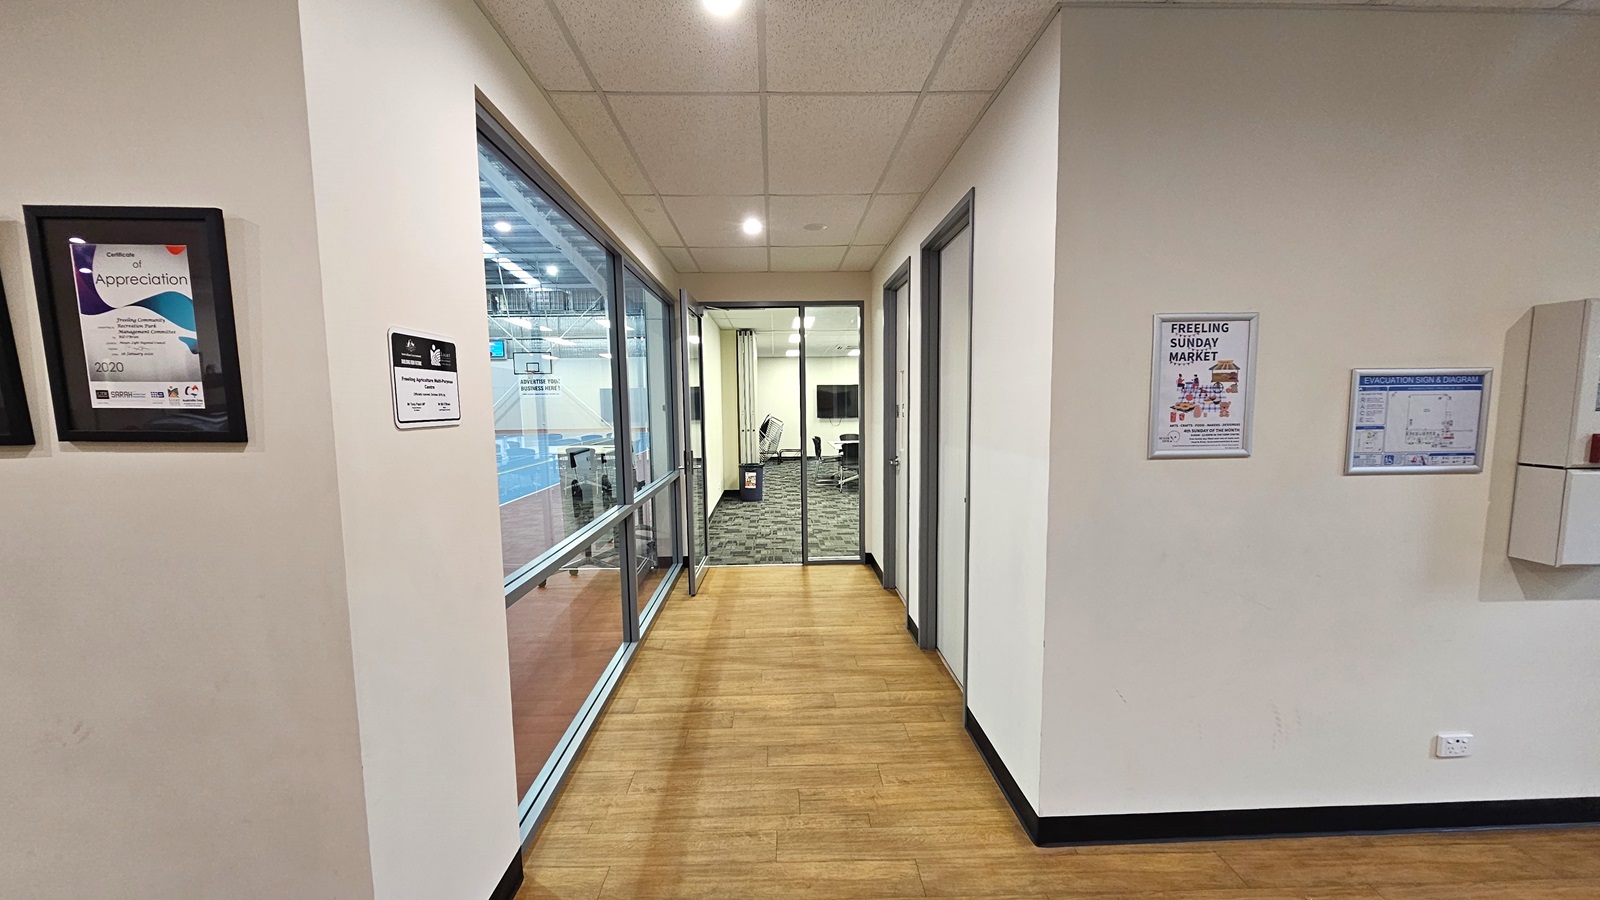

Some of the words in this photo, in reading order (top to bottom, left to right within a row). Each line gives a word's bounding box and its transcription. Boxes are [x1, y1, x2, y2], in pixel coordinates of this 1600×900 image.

[132, 260, 142, 268] of
[96, 273, 188, 287] Appreciation
[1171, 323, 1229, 333] FREELING
[1170, 338, 1219, 348] SUNDAY
[1169, 352, 1218, 362] MARKET
[95, 362, 124, 372] 2020
